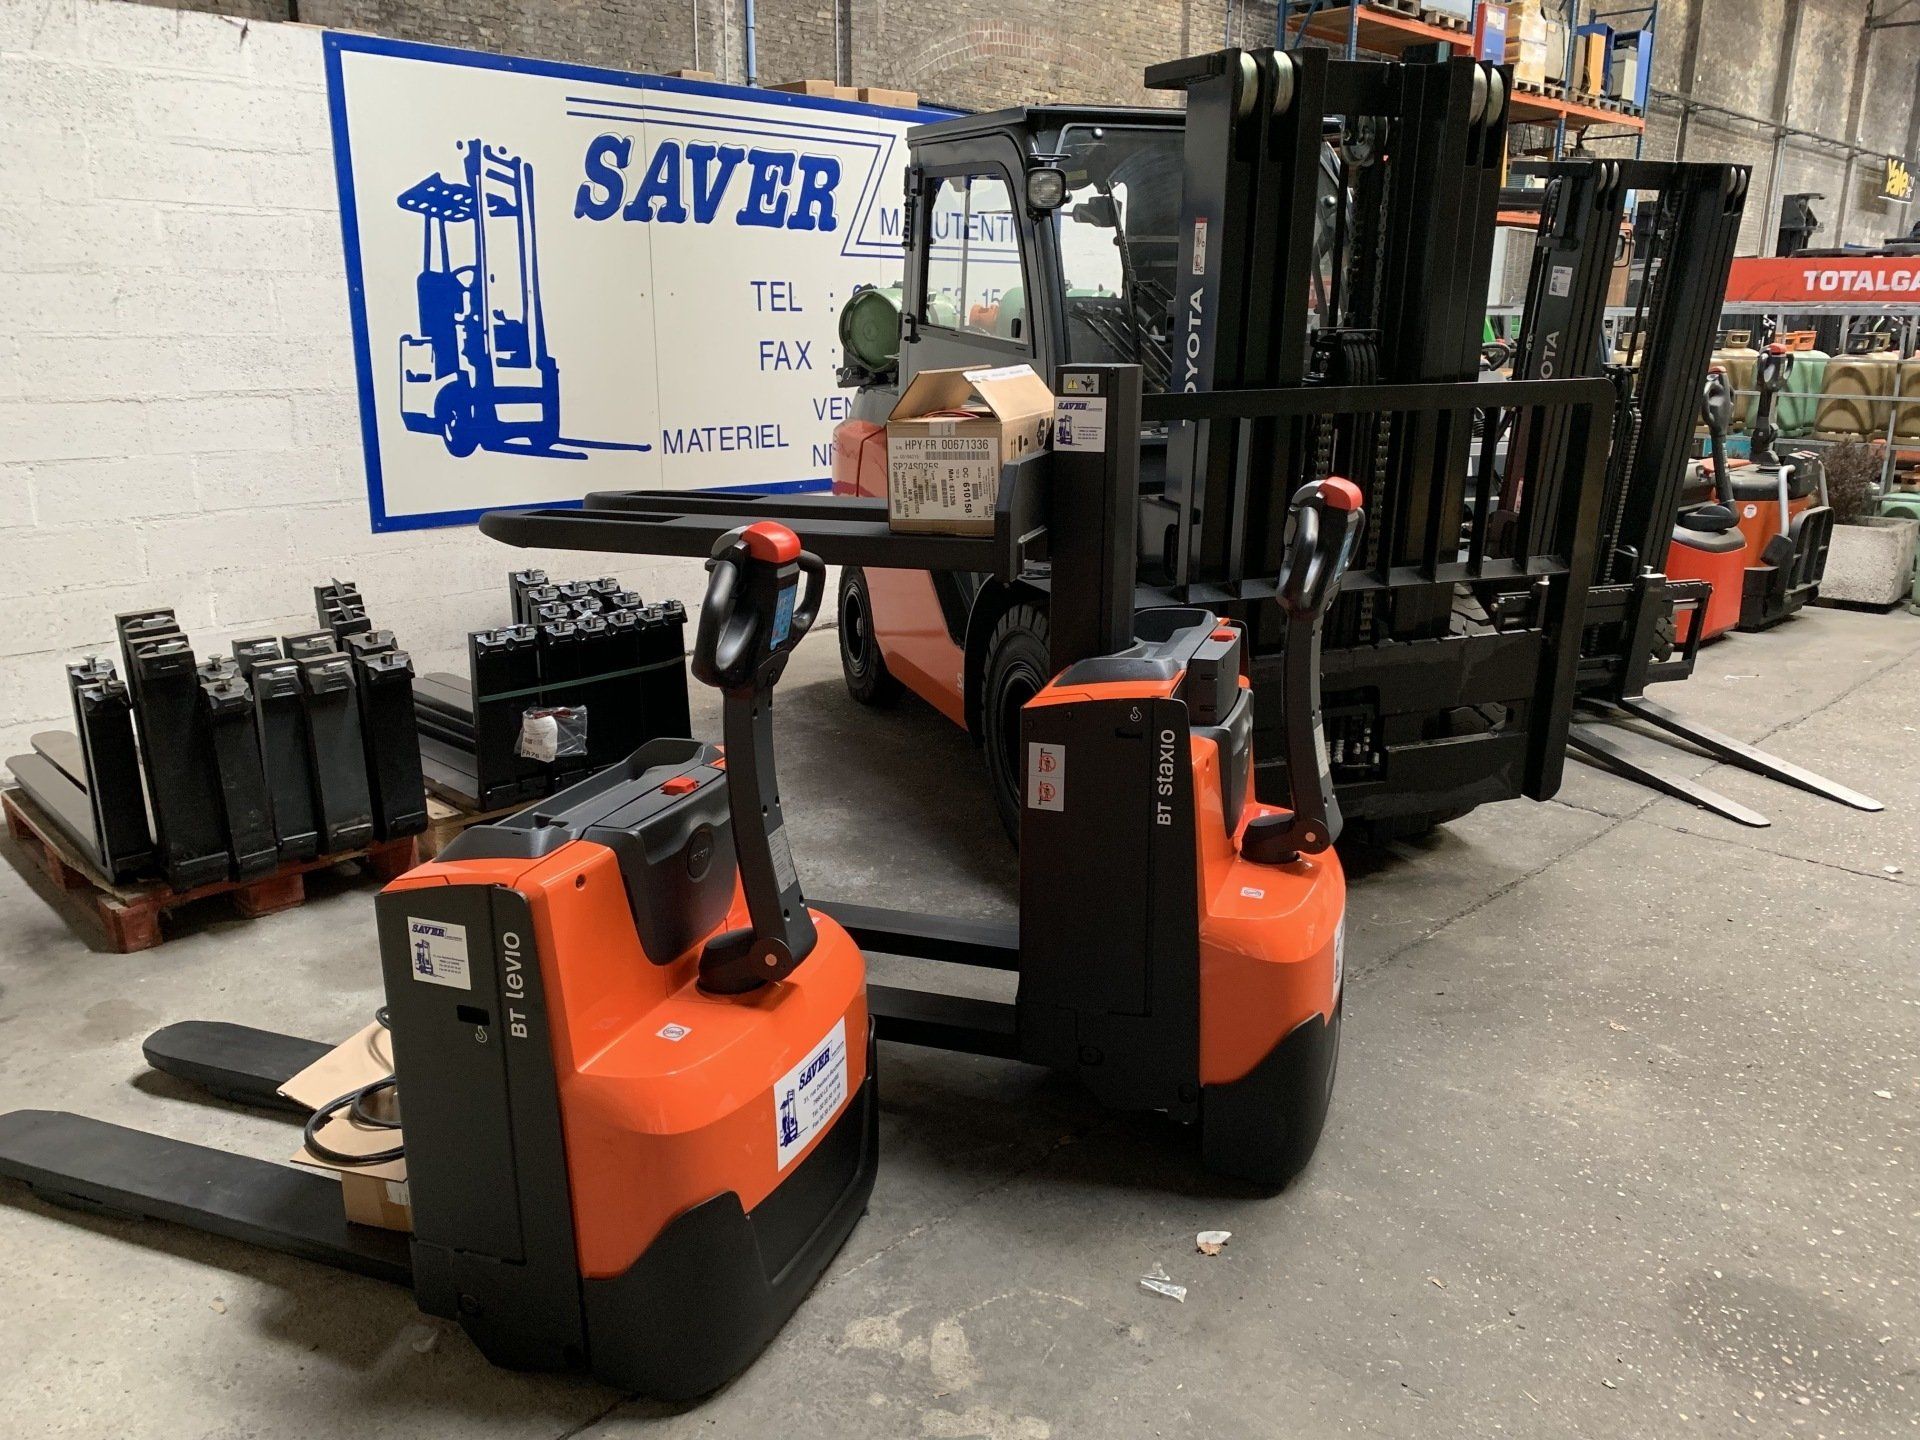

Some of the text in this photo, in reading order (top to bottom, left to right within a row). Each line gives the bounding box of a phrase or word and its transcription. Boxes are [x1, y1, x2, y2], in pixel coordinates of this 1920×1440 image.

[574, 132, 843, 232] SAVER
[1886, 158, 1909, 198] Yale
[750, 281, 803, 312] TEL
[759, 341, 812, 371] FAX
[1058, 402, 1088, 411] SAVER
[663, 424, 790, 454] MATERIEL
[941, 439, 989, 450] 00671336
[963, 482, 973, 514] 610158
[1157, 802, 1172, 826] BT
[412, 924, 445, 937] SAVER
[509, 1008, 528, 1038] BT
[799, 1047, 830, 1091] SAVER
